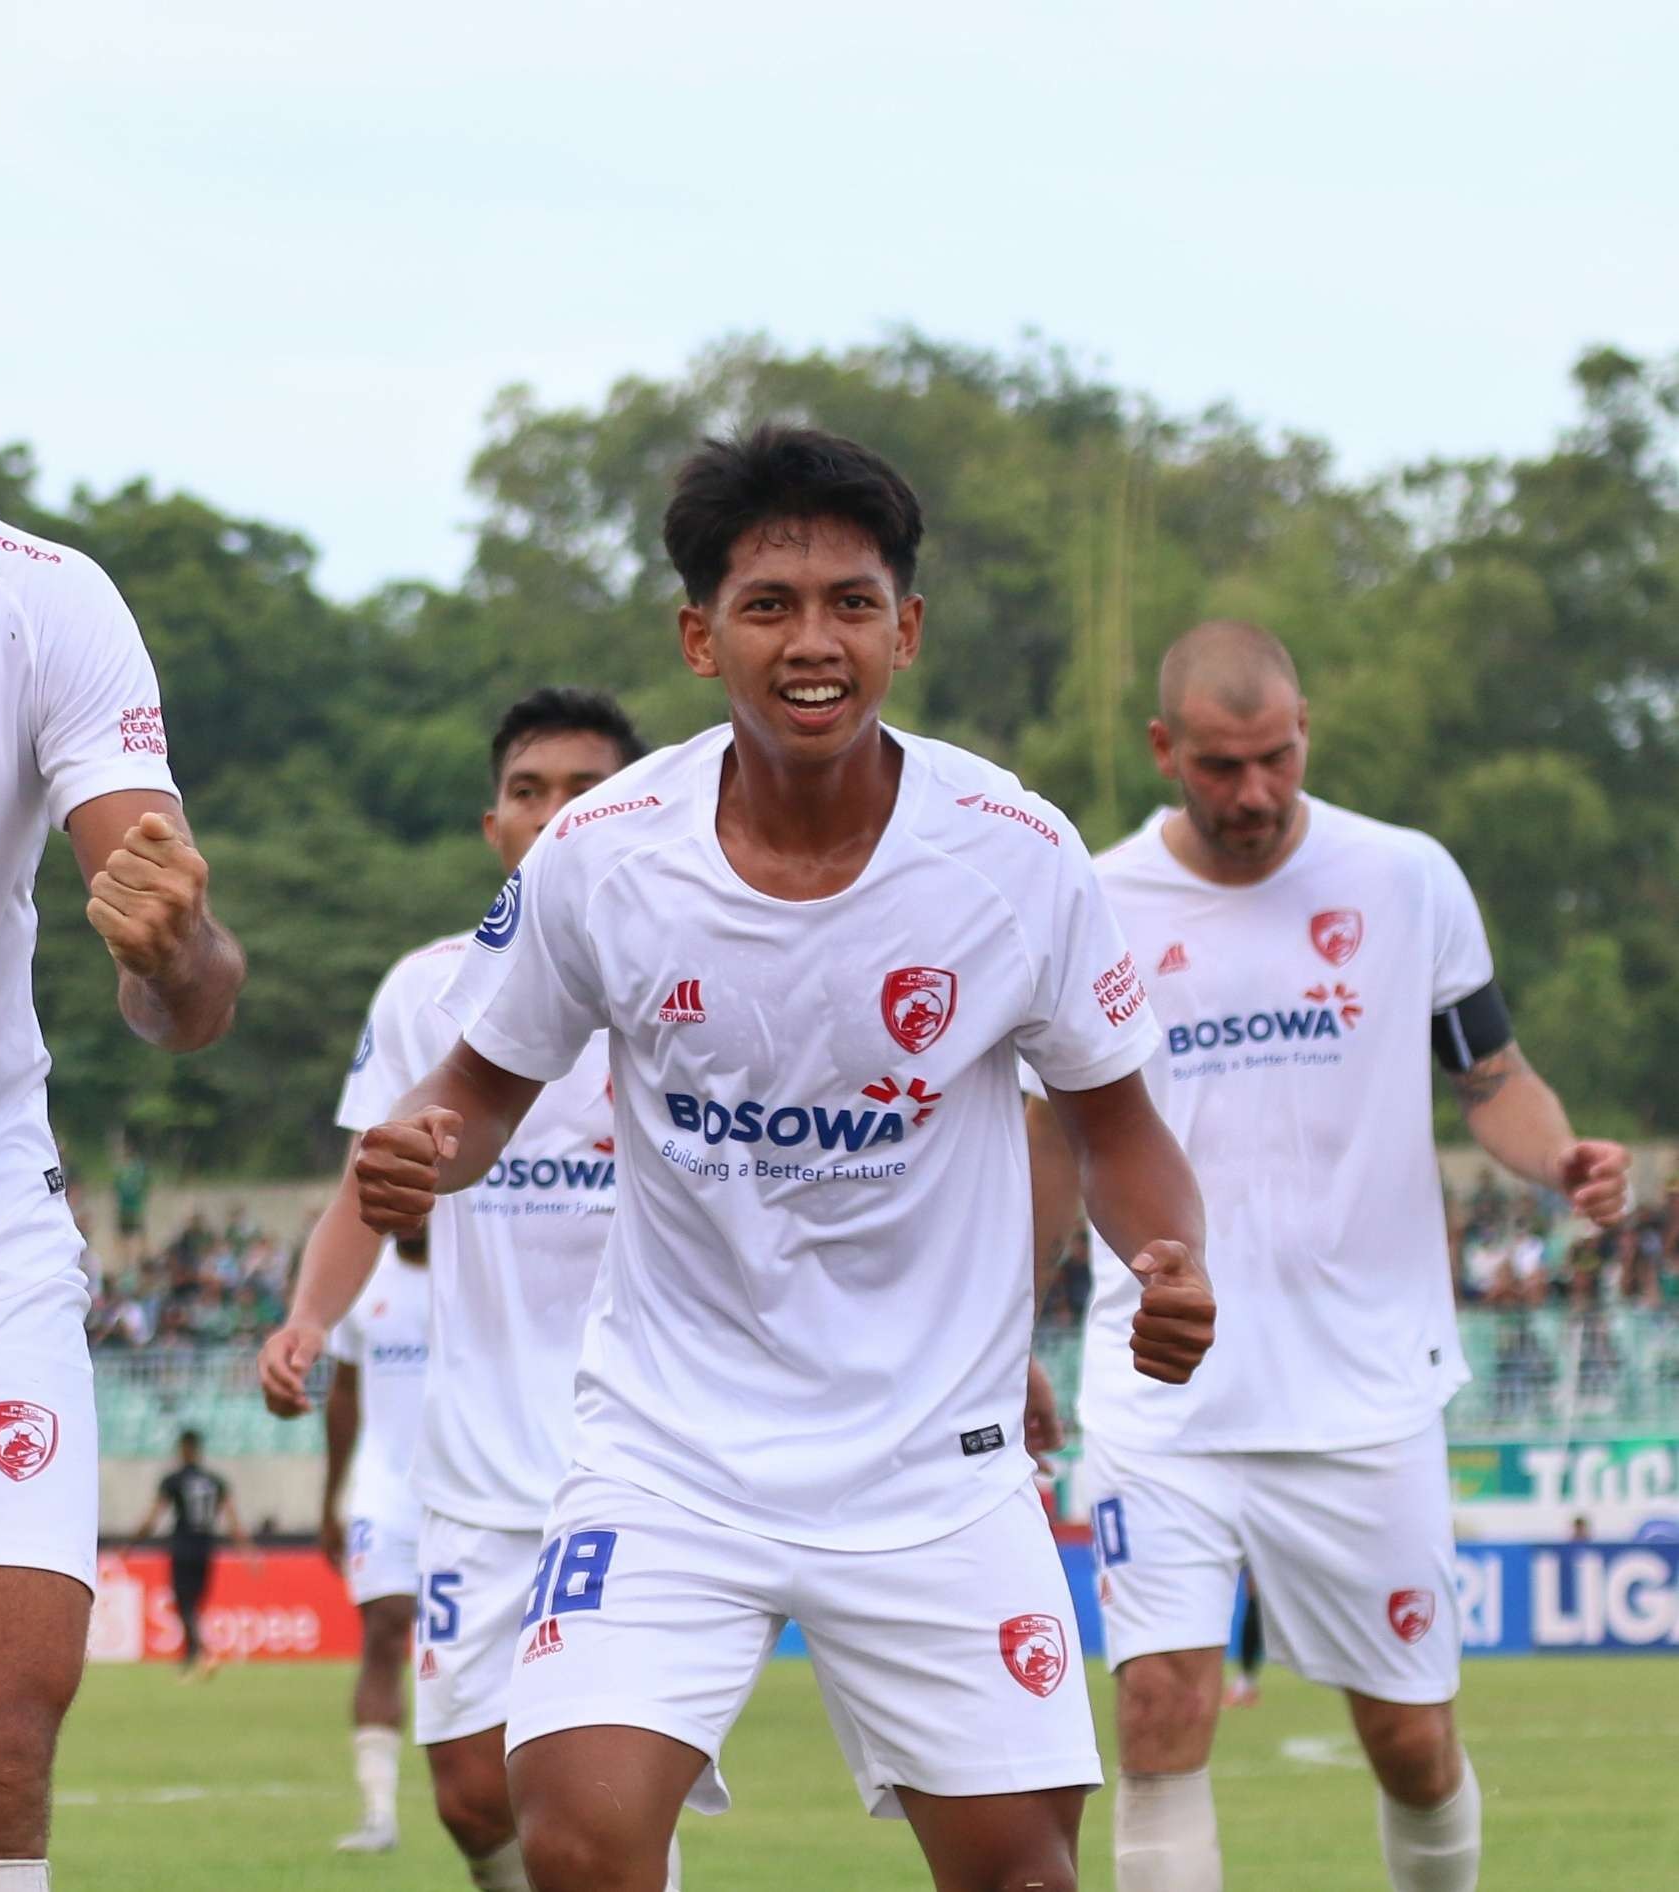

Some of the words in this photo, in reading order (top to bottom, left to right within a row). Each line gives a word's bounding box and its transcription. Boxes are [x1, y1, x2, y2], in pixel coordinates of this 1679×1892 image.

[573, 795, 662, 827] HONDA
[980, 801, 1059, 847] HONDA
[658, 1010, 707, 1024] REWAKO
[1168, 1008, 1341, 1055] BOSOWA
[664, 1092, 905, 1153] BOSOWA
[485, 1158, 616, 1190] OSOWA
[661, 1139, 730, 1182] Building
[738, 1163, 749, 1178] a
[755, 1160, 825, 1182] Better
[833, 1161, 907, 1180] Future
[1091, 1498, 1131, 1567] 0
[146, 1588, 320, 1655] Sopee
[418, 1572, 463, 1642] 5
[1533, 1550, 1679, 1646] LIG
